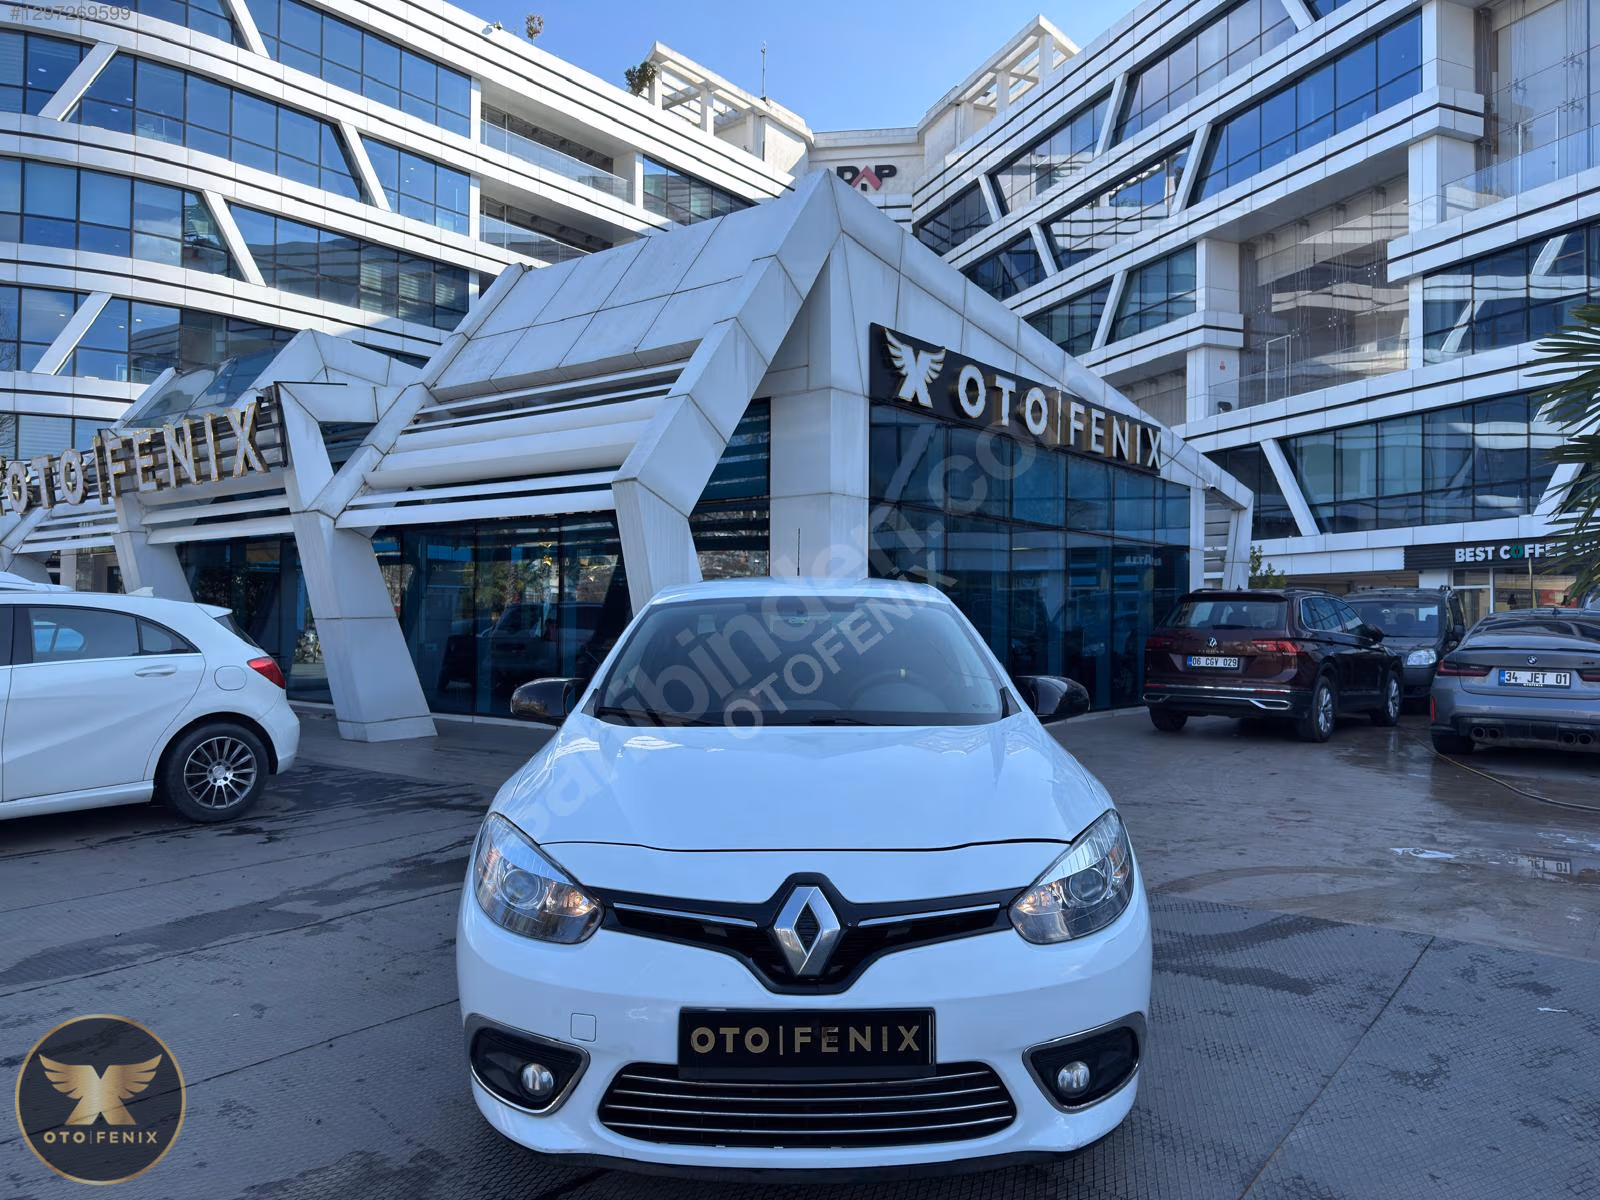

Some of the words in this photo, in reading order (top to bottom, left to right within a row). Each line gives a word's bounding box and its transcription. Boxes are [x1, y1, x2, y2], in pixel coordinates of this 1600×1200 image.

[1455, 546, 1495, 562] BEST
[1192, 657, 1202, 666] 06
[1205, 657, 1219, 666] CGV
[1222, 658, 1238, 667] 029
[1505, 671, 1518, 683] 34
[1527, 672, 1548, 684] JET
[1555, 673, 1568, 685] 01
